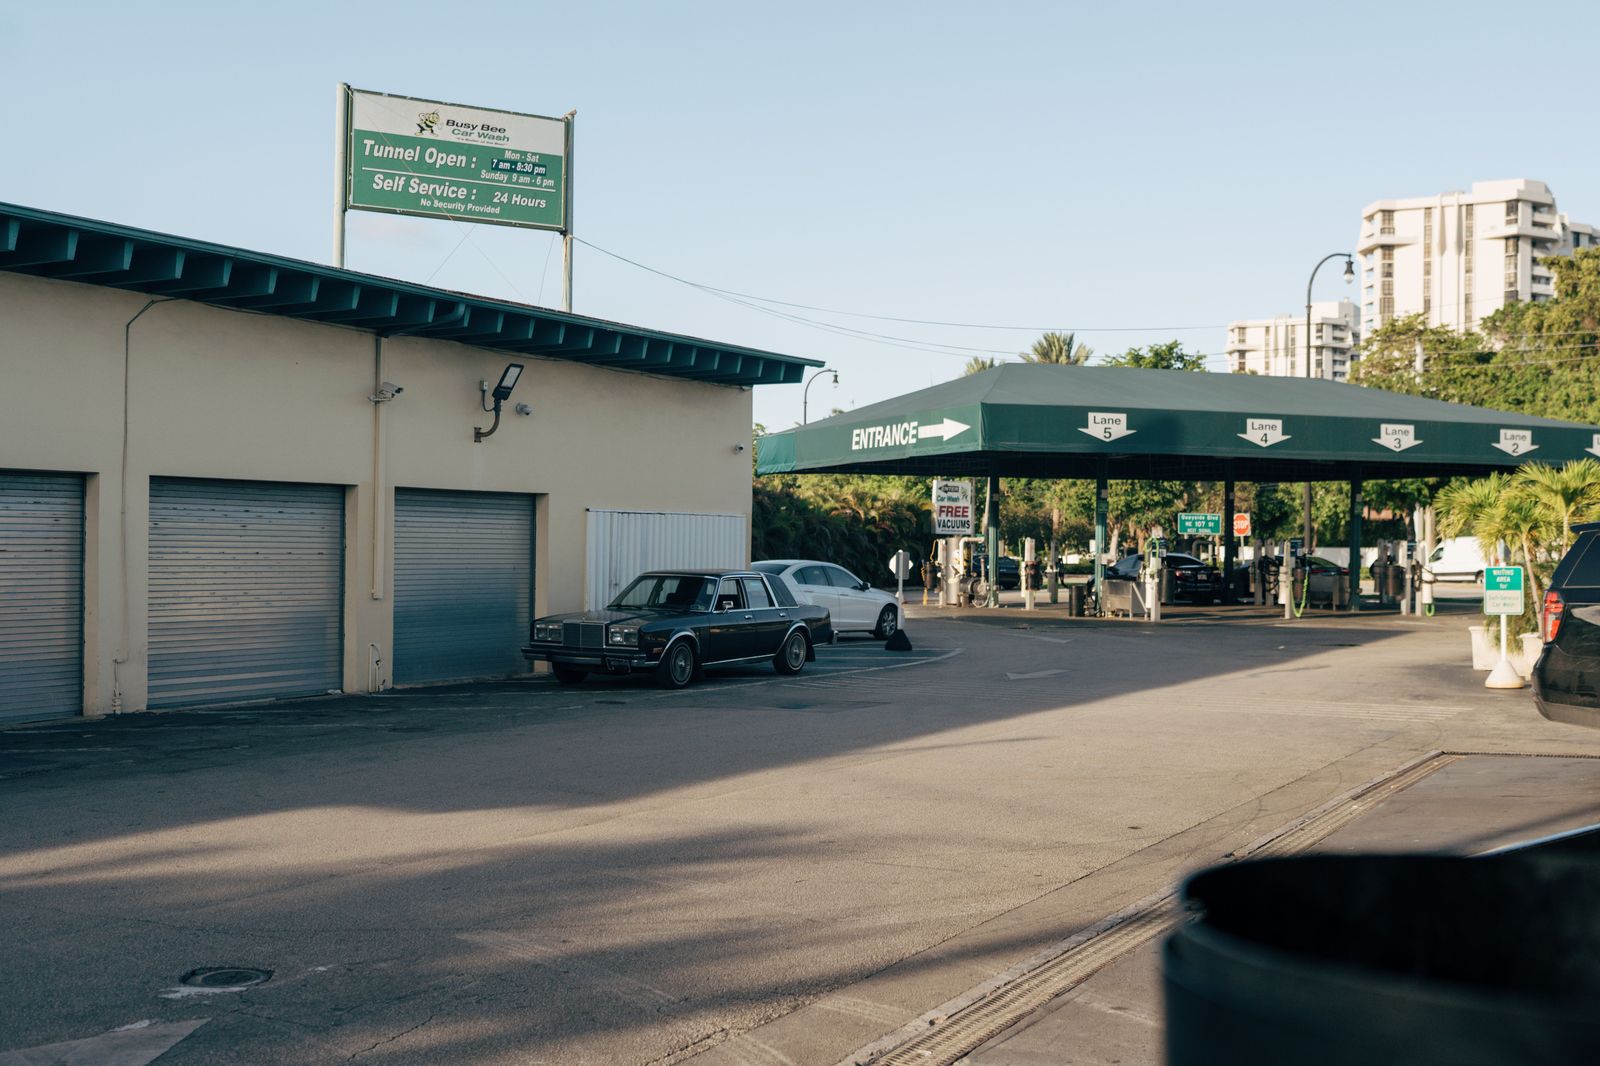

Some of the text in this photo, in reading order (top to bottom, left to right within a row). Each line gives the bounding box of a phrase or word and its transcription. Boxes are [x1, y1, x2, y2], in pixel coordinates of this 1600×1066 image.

[446, 119, 506, 134] Busy Bee
[451, 129, 474, 137] Car
[477, 132, 510, 142] Wash
[363, 139, 420, 161] Tunnel
[424, 147, 467, 168] Open
[504, 150, 520, 160] Mon
[526, 153, 539, 162] Sat
[492, 159, 498, 168] 7
[498, 162, 510, 170] am
[516, 162, 533, 172] 8:30
[533, 166, 546, 175] pm
[480, 169, 508, 183] Sunday
[512, 173, 517, 182] 9
[536, 176, 542, 185] 6
[542, 179, 554, 187] pm
[372, 174, 406, 192] Self
[408, 178, 467, 199] Service
[493, 191, 509, 204] 24
[511, 193, 546, 208] Hours
[420, 198, 500, 214] No Security Provided
[1093, 415, 1121, 425] Lane
[1251, 421, 1277, 431] Lane
[851, 421, 918, 451] ENTRANCE
[1103, 427, 1112, 439] 5
[1385, 426, 1410, 436] Lane
[1504, 432, 1527, 441] Lane
[1260, 432, 1268, 444] 4
[1393, 437, 1402, 449] 3
[1511, 443, 1519, 454] 2
[939, 505, 969, 518] FREE
[937, 519, 970, 529] VACUUMS
[1234, 520, 1249, 530] STOP
